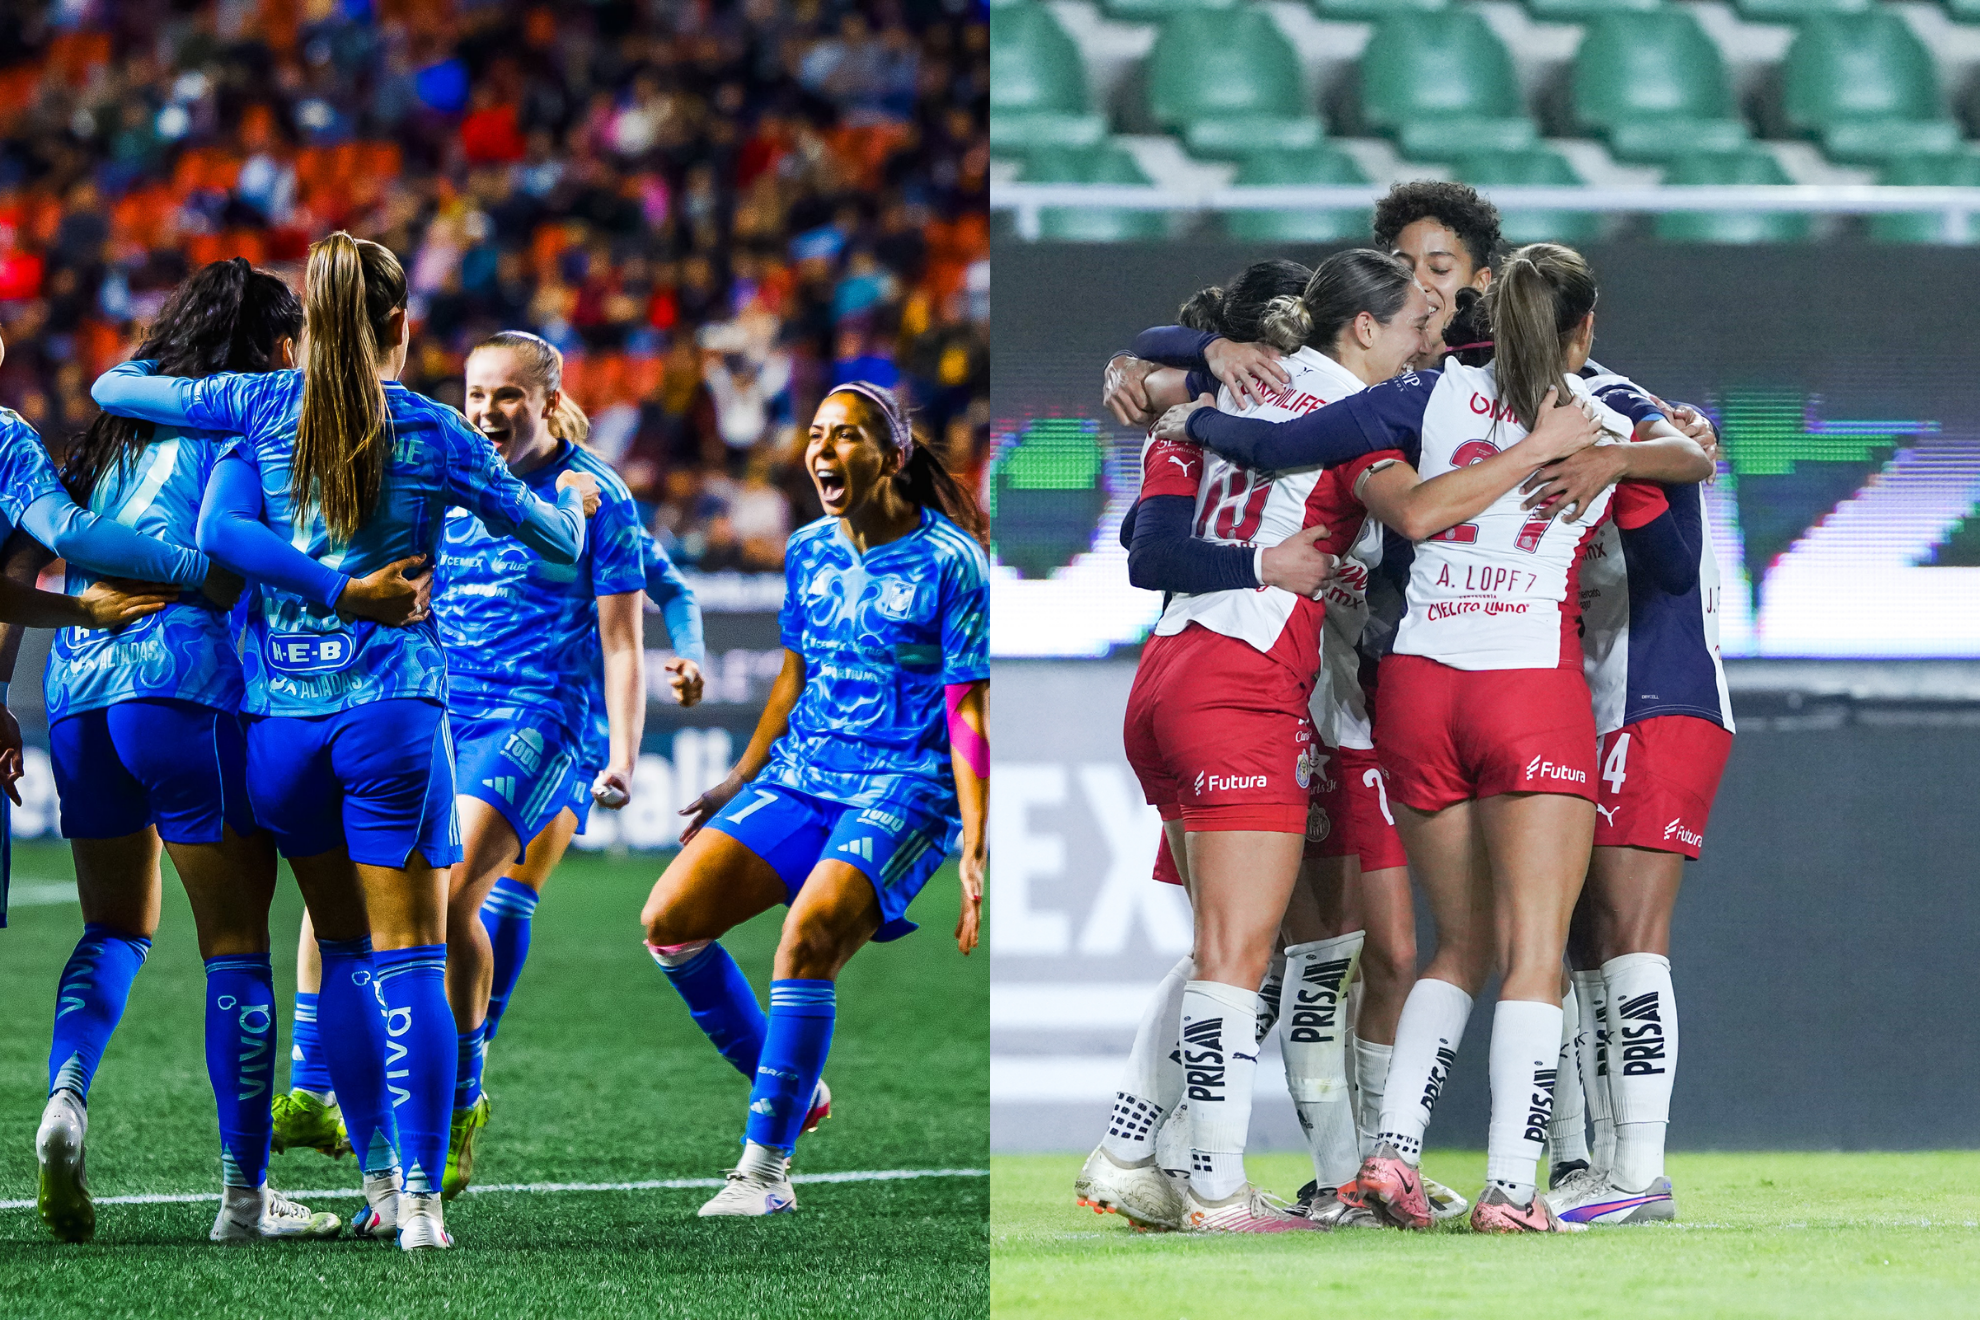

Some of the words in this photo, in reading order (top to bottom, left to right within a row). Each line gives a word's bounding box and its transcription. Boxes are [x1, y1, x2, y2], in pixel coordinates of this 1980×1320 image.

[447, 557, 483, 568] CEMEX
[100, 639, 159, 671] ALIADAS
[272, 641, 342, 663] H-E-B
[300, 669, 363, 699] ALIADAS
[1208, 774, 1268, 792] Futura
[1540, 761, 1587, 784] Futura
[726, 788, 780, 826] 7
[1676, 825, 1703, 848] Futura
[238, 1003, 271, 1100] viva
[386, 1006, 412, 1109] viva
